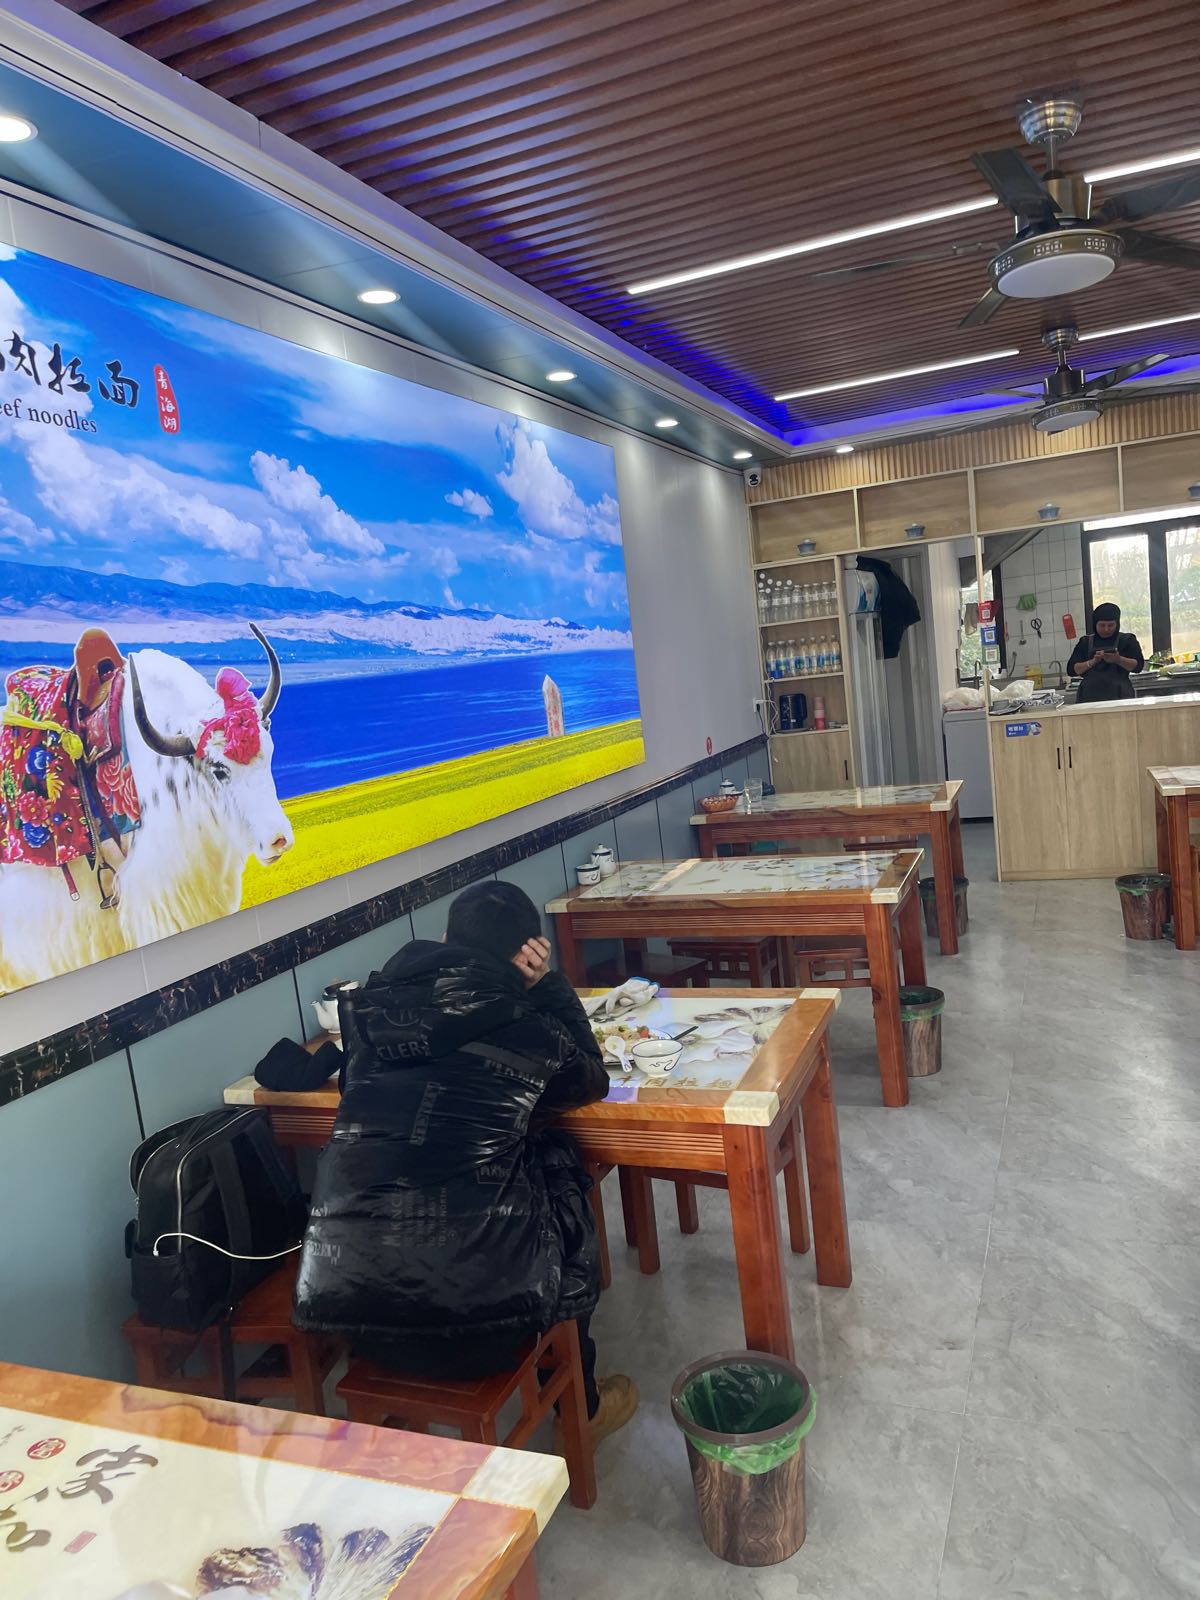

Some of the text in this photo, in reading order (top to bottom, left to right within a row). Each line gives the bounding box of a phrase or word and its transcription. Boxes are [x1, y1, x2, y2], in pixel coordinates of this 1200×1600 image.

[0, 398, 97, 433] ef noodles
[157, 369, 177, 431] 青海湖
